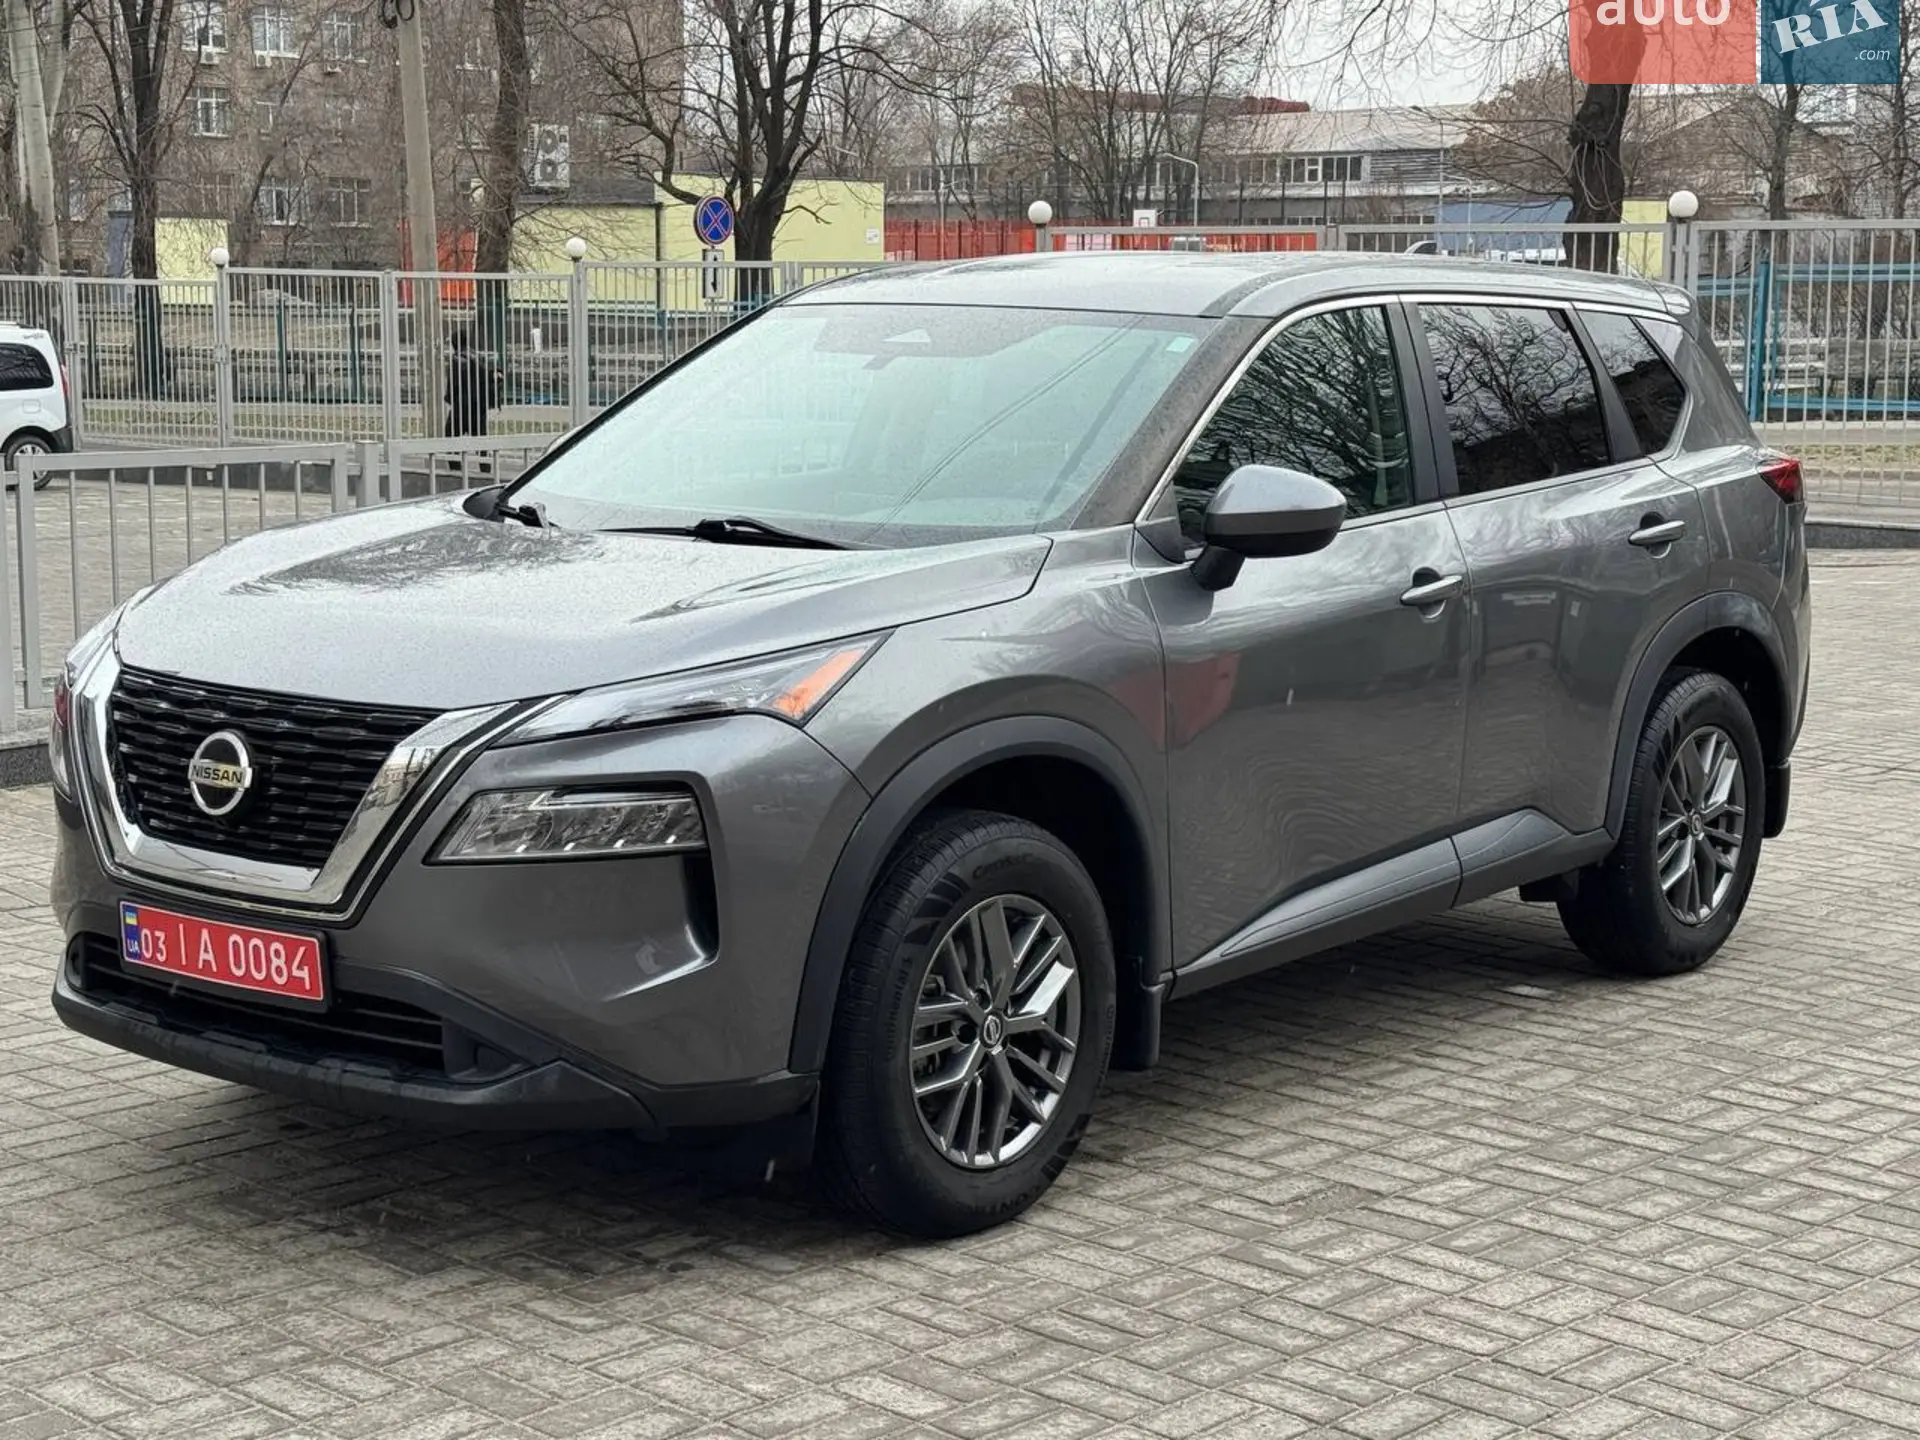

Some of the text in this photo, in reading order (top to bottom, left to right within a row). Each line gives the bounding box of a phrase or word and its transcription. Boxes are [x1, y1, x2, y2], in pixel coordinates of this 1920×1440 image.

[191, 764, 243, 784] NISSAN
[126, 938, 140, 953] UA
[141, 928, 167, 962] 03
[227, 933, 312, 991] 0084
